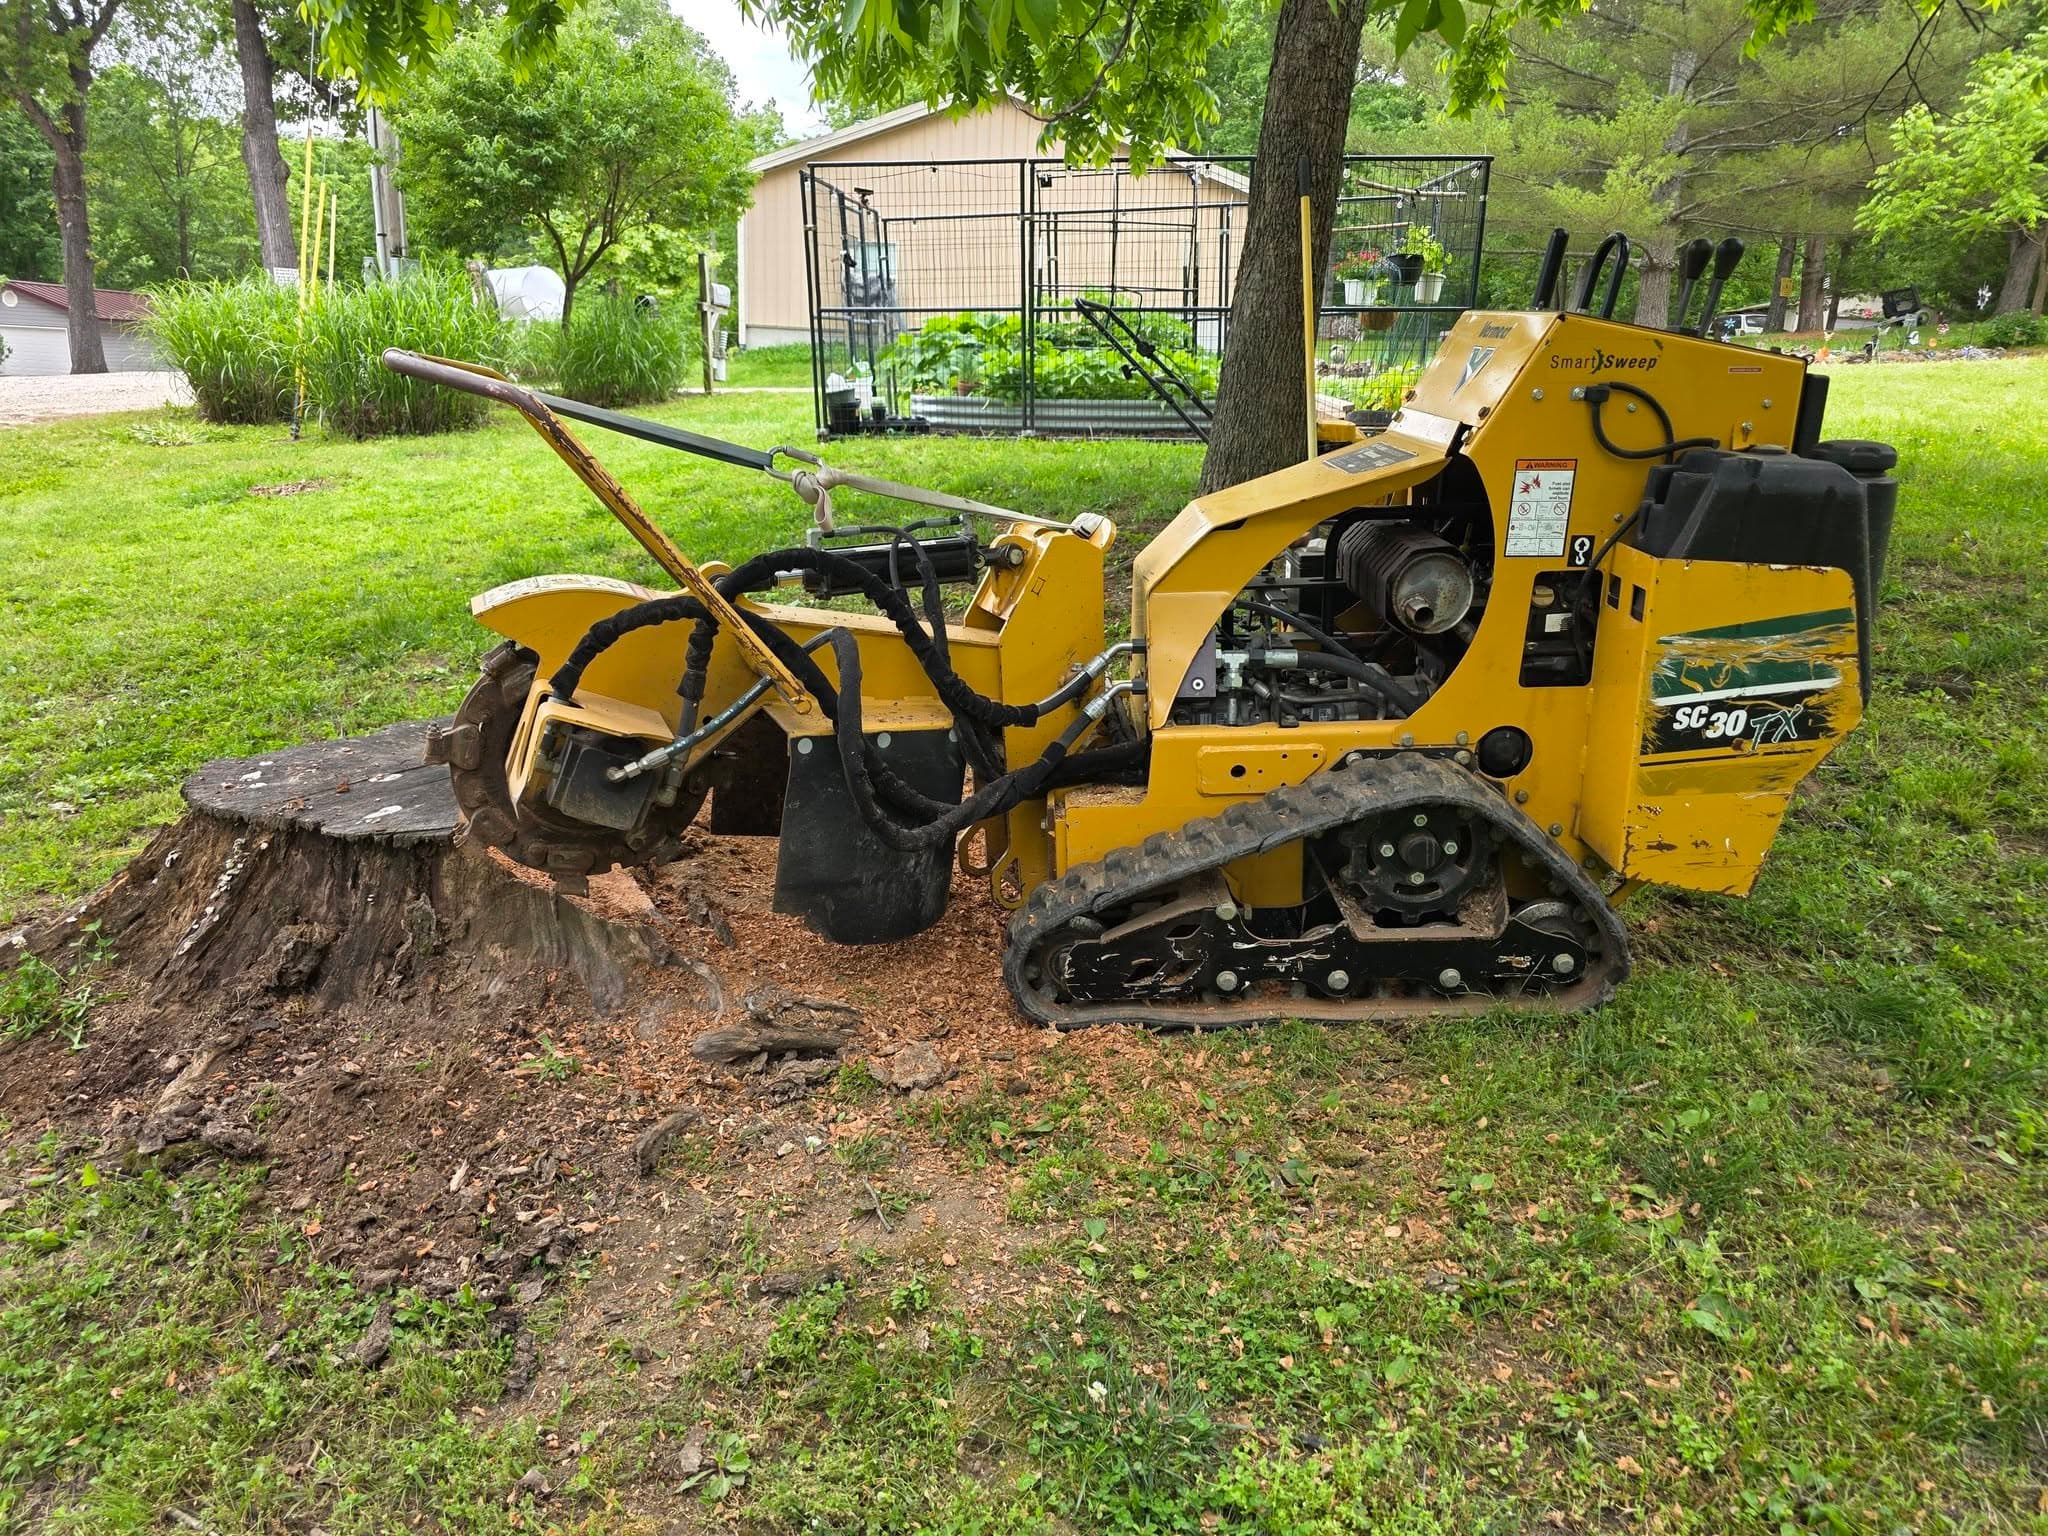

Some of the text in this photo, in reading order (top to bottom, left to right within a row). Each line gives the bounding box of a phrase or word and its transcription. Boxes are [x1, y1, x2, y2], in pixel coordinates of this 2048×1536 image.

[1550, 354, 1658, 372] Smart Sweep
[1534, 461, 1568, 469] WARNING
[1750, 704, 1803, 752] TX
